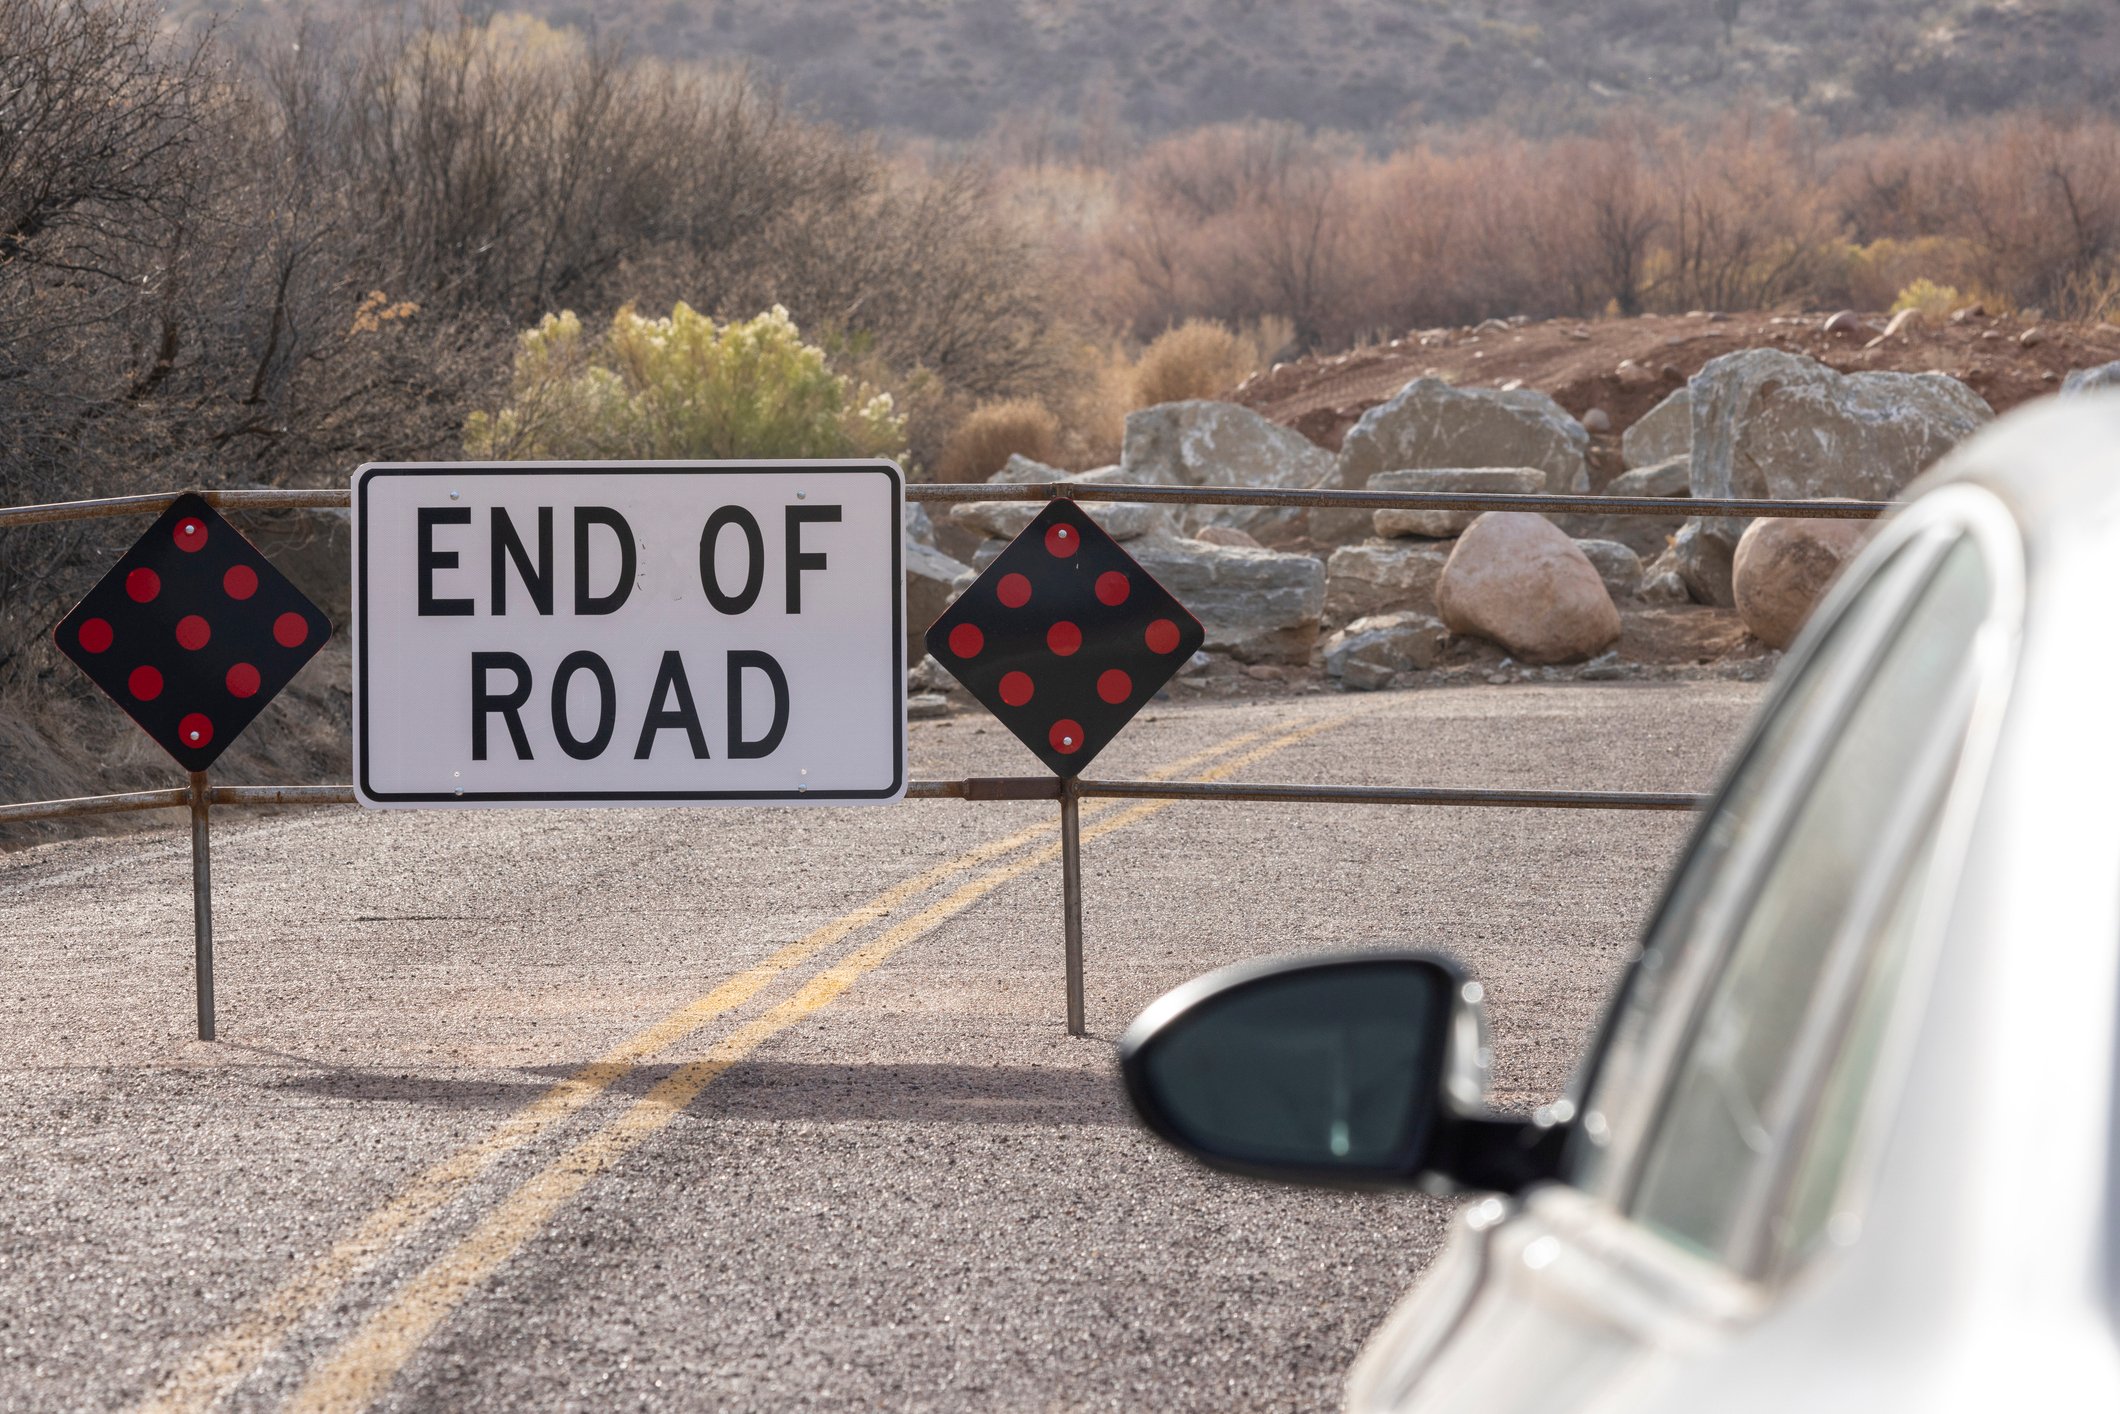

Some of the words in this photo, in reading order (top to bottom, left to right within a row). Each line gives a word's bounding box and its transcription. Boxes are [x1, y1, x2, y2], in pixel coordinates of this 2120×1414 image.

[417, 506, 637, 616] END
[699, 504, 843, 615] OF
[471, 649, 790, 761] ROAD
